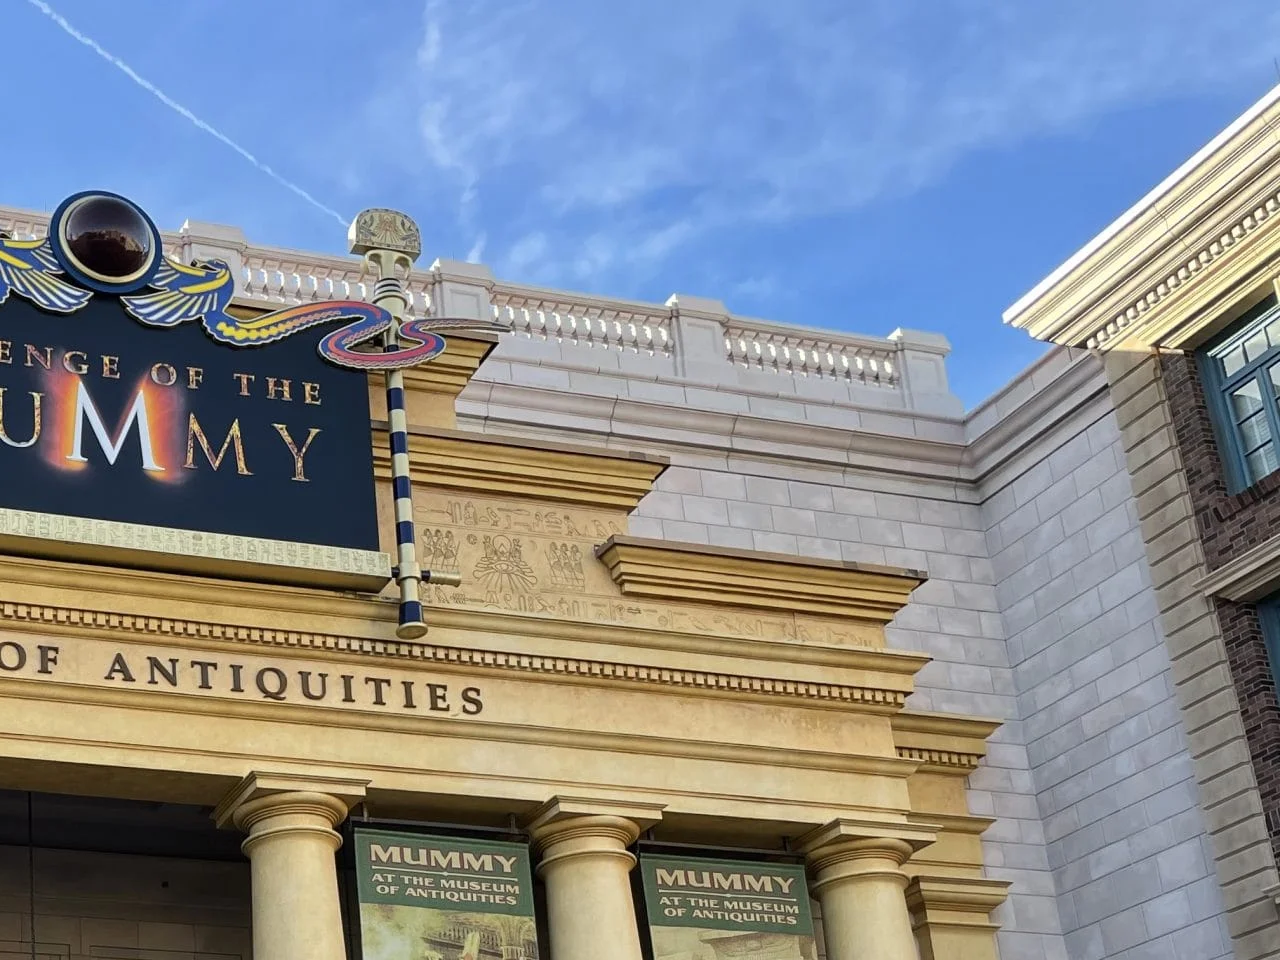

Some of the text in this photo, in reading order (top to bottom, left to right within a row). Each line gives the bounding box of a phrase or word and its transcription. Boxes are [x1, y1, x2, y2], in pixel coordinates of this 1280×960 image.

[150, 361, 204, 389] OF
[234, 372, 322, 405] THE
[104, 652, 484, 715] ANTIQUITIES
[370, 844, 517, 873] MUMMY
[371, 873, 520, 894] AT THE MUSEUM
[655, 868, 794, 894] MUMMY
[376, 885, 517, 906] OF ANTIQUITIES
[659, 896, 799, 914] AT THE MUSEUM
[664, 908, 797, 925] OF ANTIQUITIES
